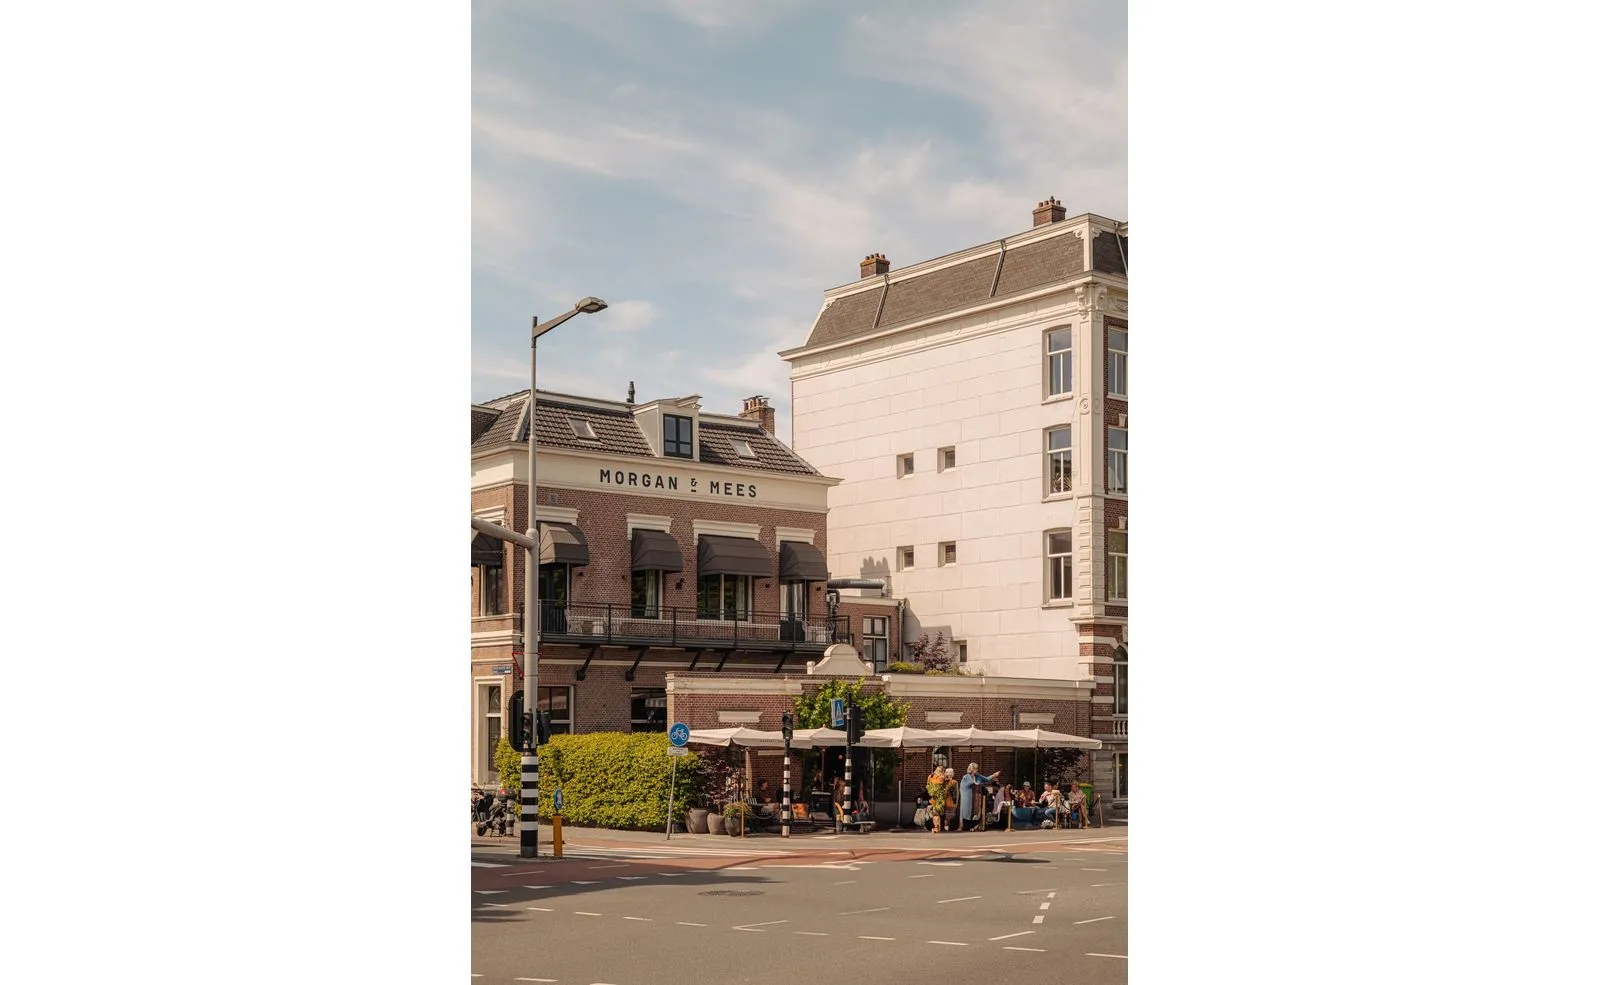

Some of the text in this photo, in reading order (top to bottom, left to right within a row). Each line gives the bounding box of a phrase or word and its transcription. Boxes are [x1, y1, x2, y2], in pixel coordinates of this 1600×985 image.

[599, 468, 757, 498] MORGAN & MEES
